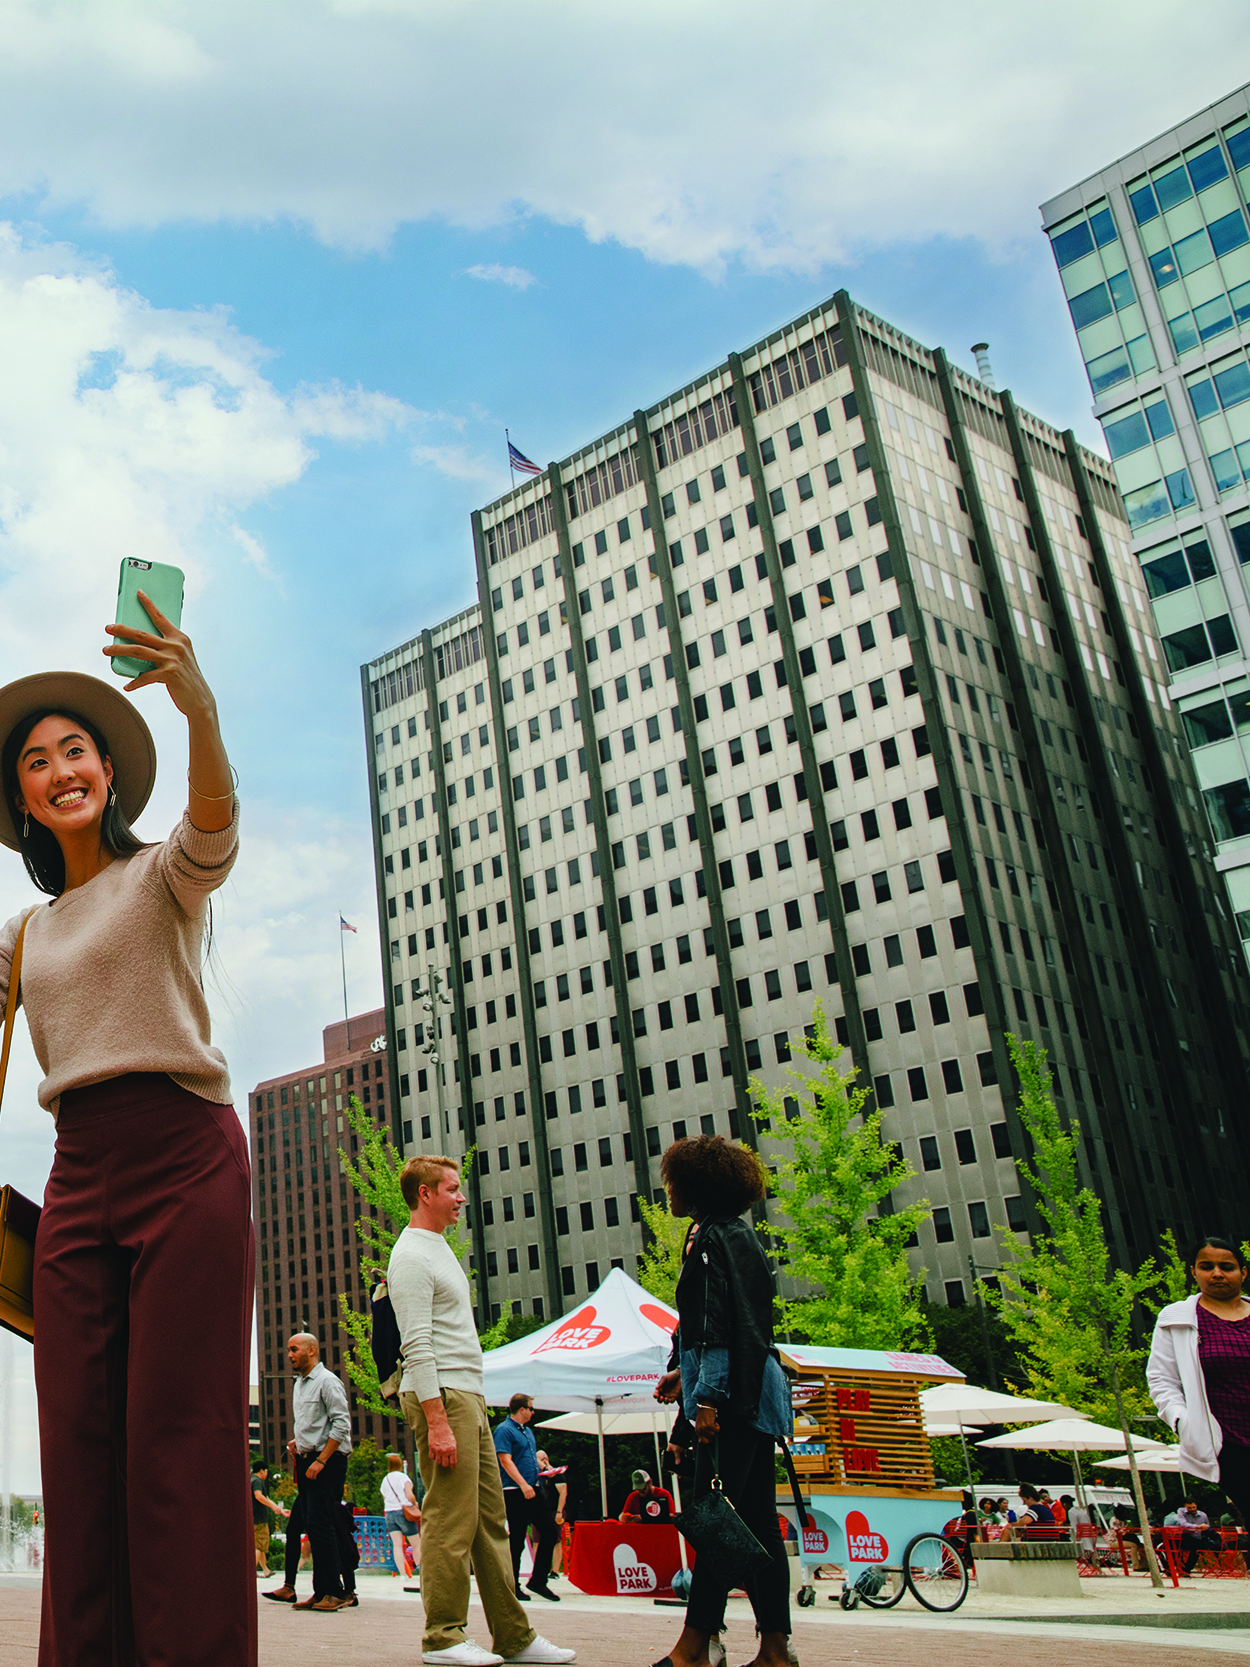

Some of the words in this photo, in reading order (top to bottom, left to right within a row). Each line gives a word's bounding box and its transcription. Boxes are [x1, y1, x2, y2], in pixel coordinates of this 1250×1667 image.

[547, 1327, 604, 1343] LOVE
[606, 1373, 660, 1383] #LOVEPARK
[836, 1388, 871, 1412] PLAY
[843, 1447, 881, 1472] LOVE
[803, 1532, 824, 1542] LOVE
[849, 1534, 881, 1547] LOVE
[804, 1541, 826, 1551] PARK
[851, 1547, 884, 1560] PARK
[618, 1567, 648, 1578] LOVE
[620, 1578, 652, 1590] PARK
